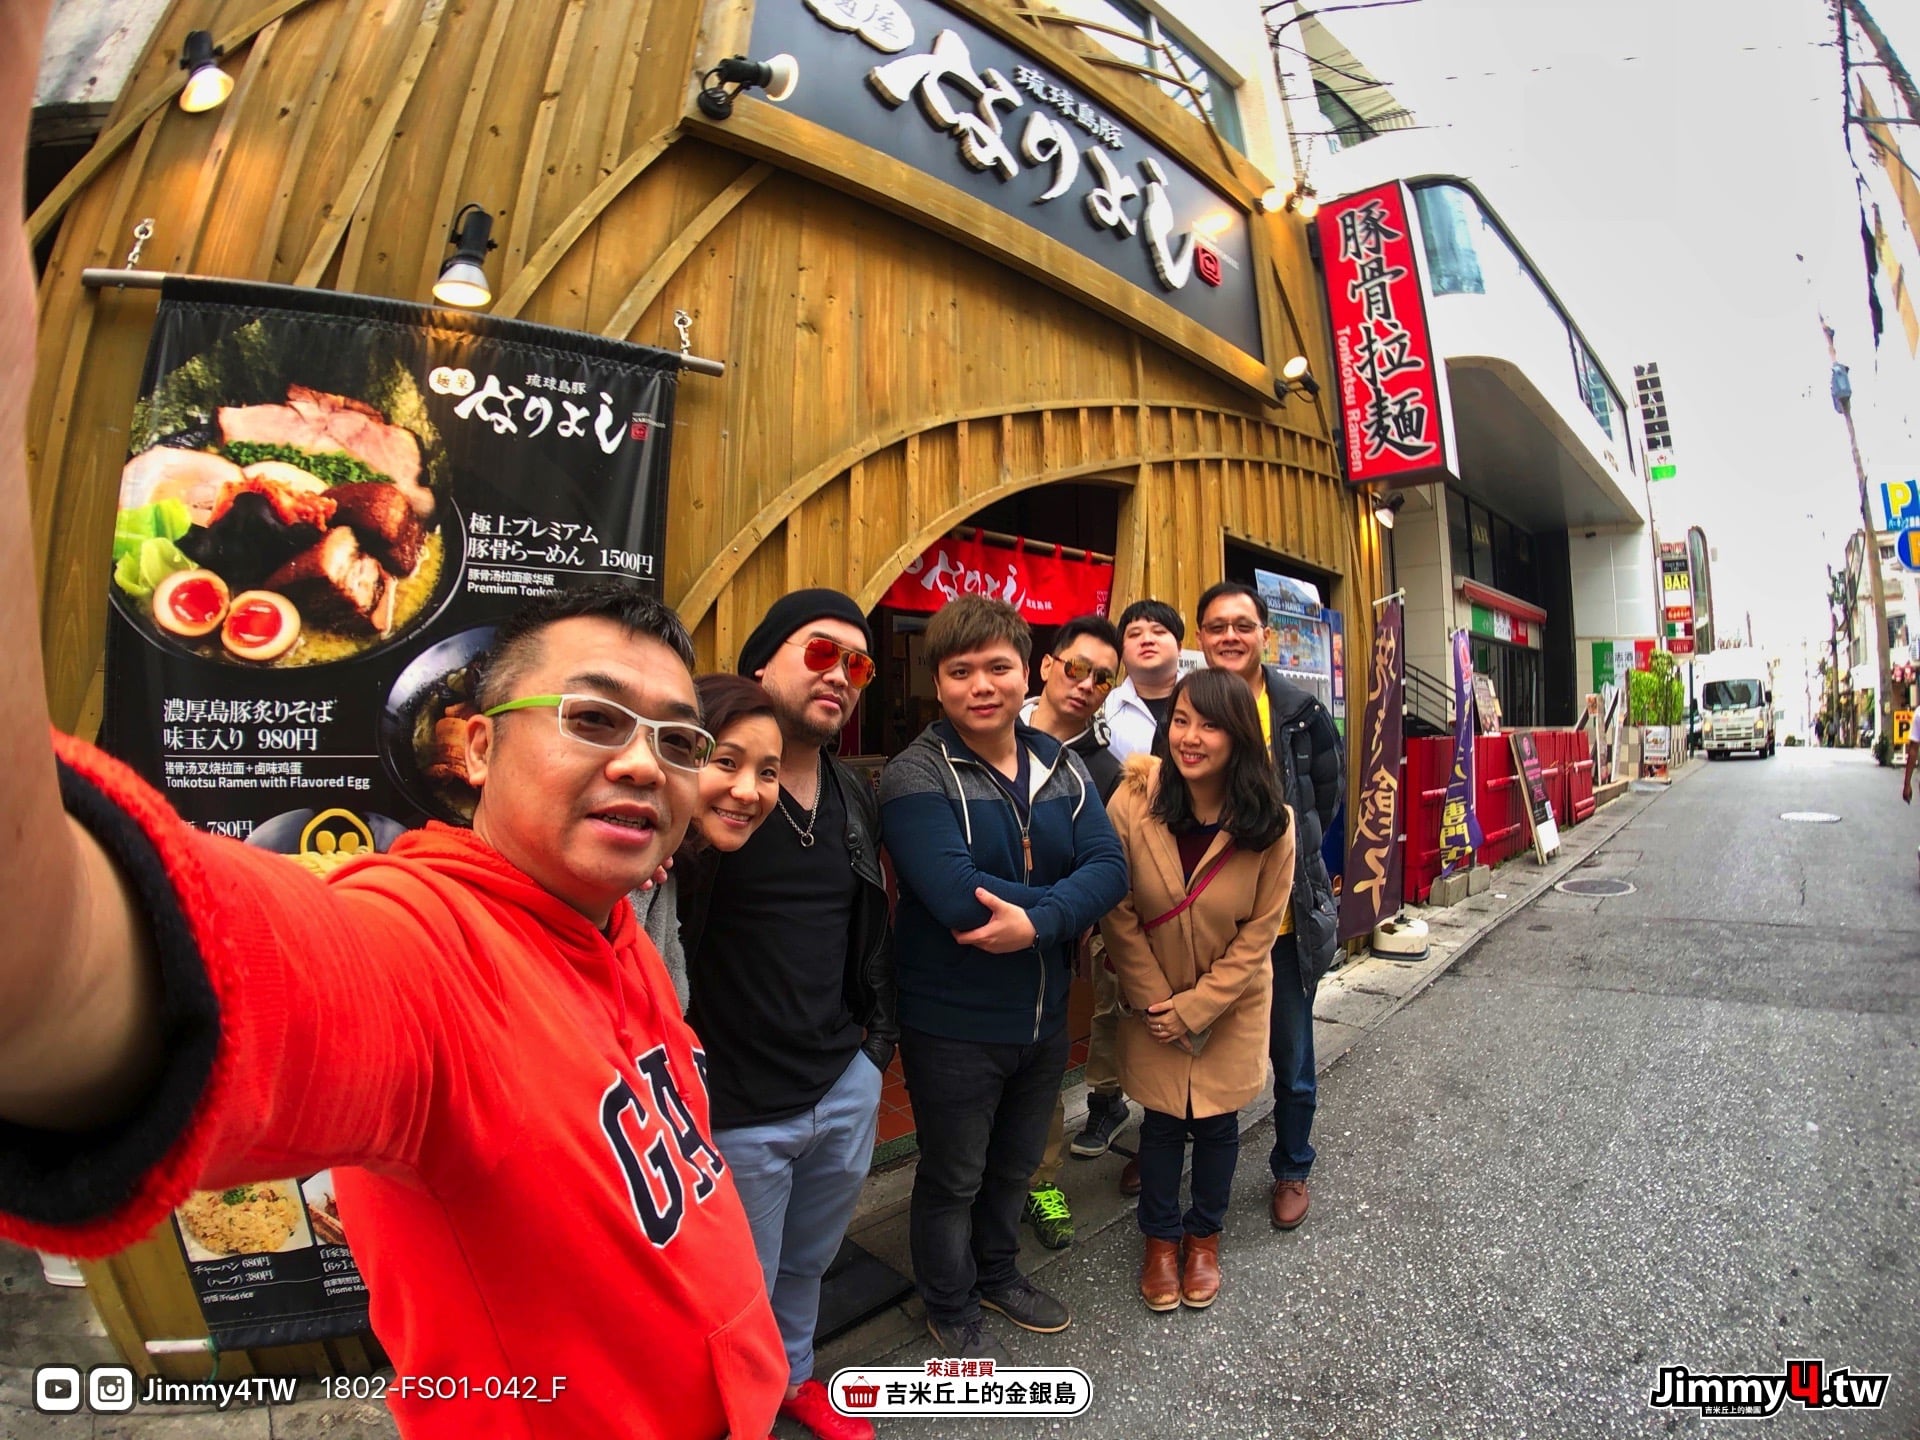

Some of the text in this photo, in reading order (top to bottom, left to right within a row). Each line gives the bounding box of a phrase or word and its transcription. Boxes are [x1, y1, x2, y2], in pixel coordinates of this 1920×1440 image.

[525, 373, 588, 395] 琉球島豚
[1336, 325, 1365, 473] Tonkotsu Ramen
[1888, 482, 1912, 518] P
[468, 512, 599, 544] 極上プレミアム
[467, 537, 653, 575] 豚骨らーめん 1500円
[467, 582, 518, 595] Premium
[1664, 573, 1689, 590] BAR
[163, 698, 335, 724] 濃厚島豚炙りそば
[163, 726, 318, 751] 味玉入り 980円
[1898, 721, 1910, 738] P
[166, 776, 371, 790] Tonkotsu Ramen with Flavored Egg
[193, 1256, 272, 1275] チャーハン 680円
[245, 1269, 274, 1282] 380円
